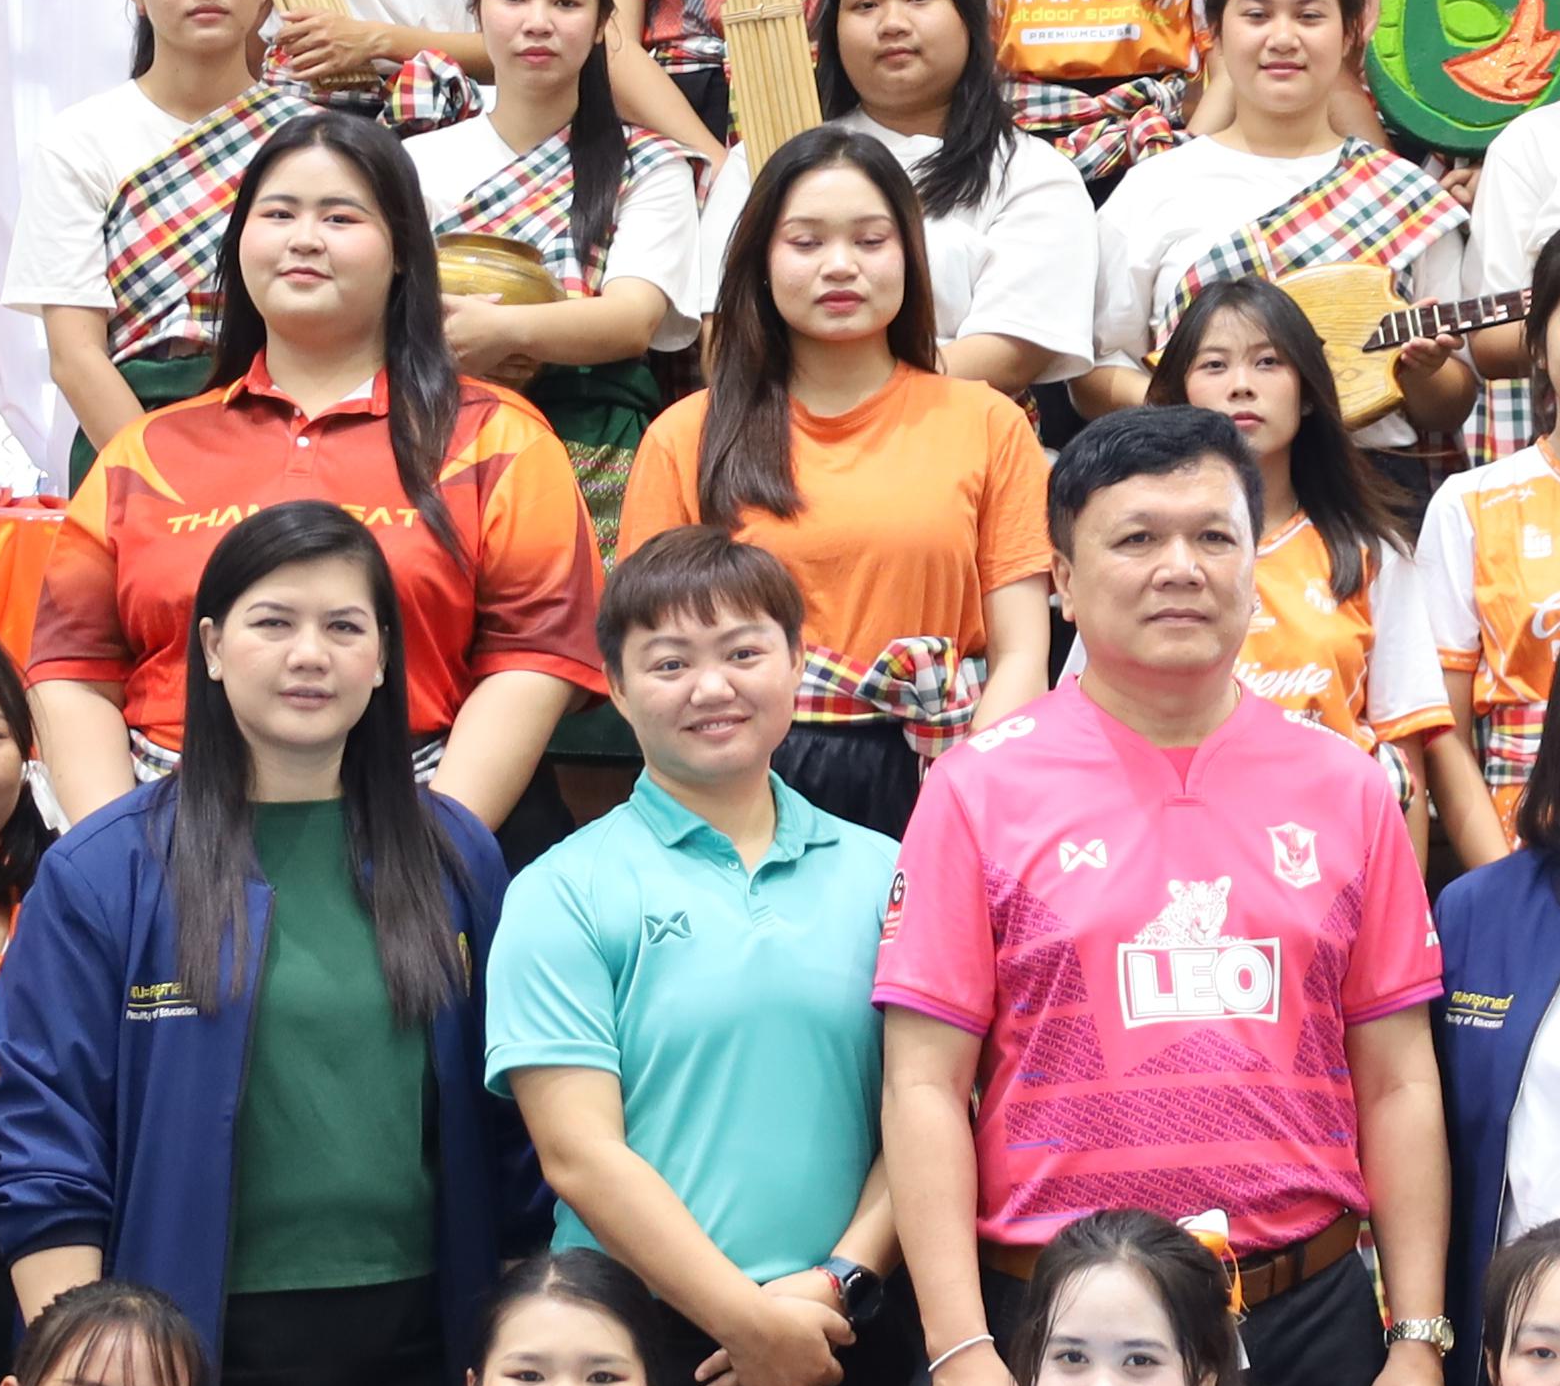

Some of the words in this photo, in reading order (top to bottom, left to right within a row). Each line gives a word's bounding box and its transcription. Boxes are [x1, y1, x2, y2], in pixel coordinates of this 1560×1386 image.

[167, 503, 419, 534] THASAT
[967, 715, 1036, 753] BG
[1125, 944, 1274, 1016] LEO
